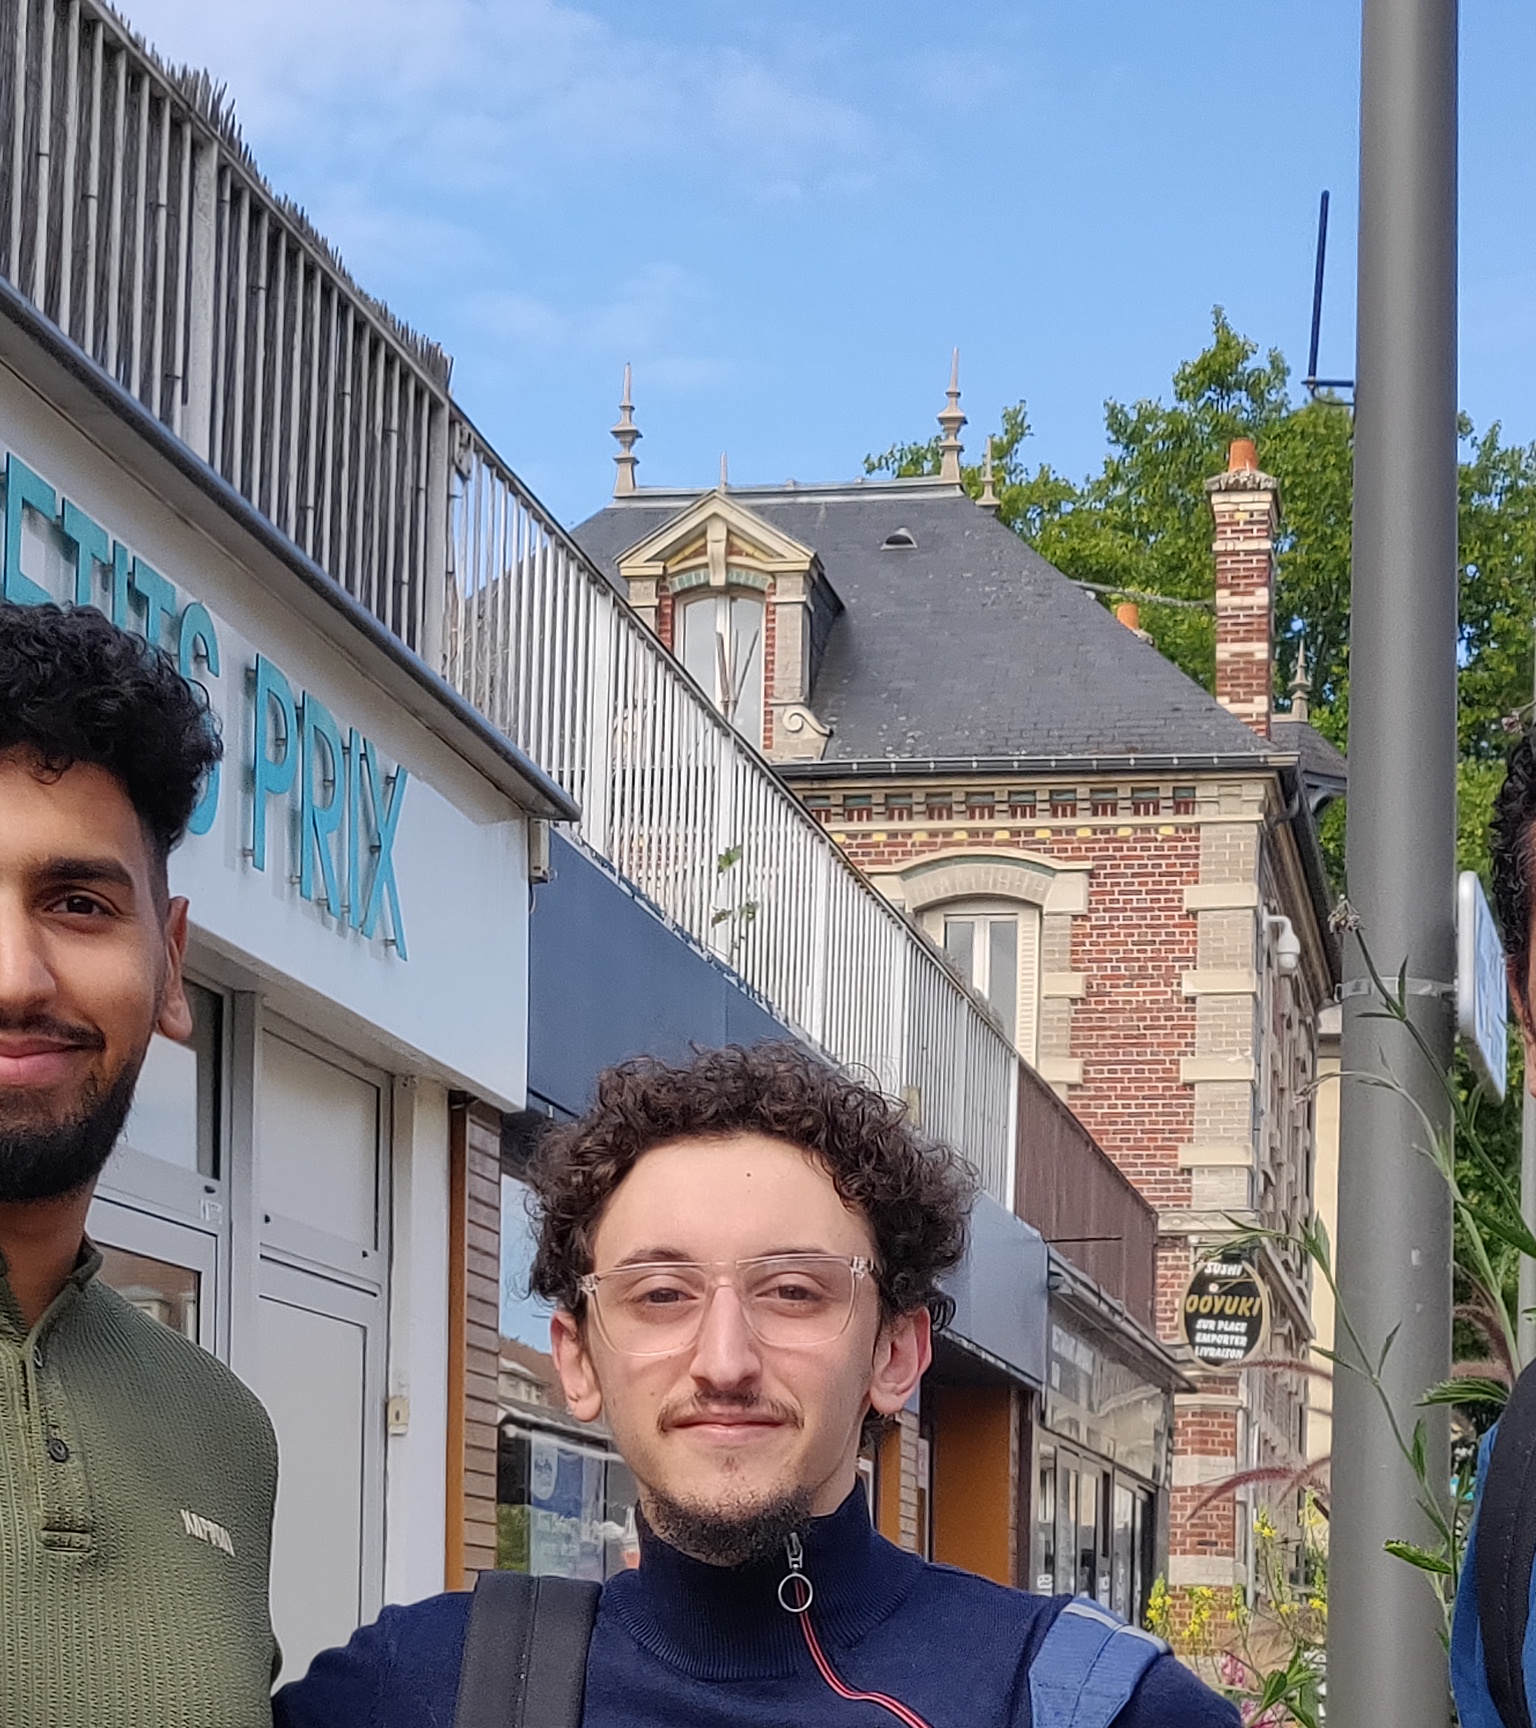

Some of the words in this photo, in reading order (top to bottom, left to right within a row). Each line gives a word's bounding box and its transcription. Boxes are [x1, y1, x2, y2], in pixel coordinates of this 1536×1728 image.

[253, 652, 409, 961] PRIX
[1204, 1261, 1243, 1276] SUSHI
[1196, 1319, 1216, 1331] SUR
[1217, 1320, 1247, 1333] PLACE
[1195, 1333, 1247, 1347] EMPORTER
[1195, 1346, 1244, 1360] LIVRAISON
